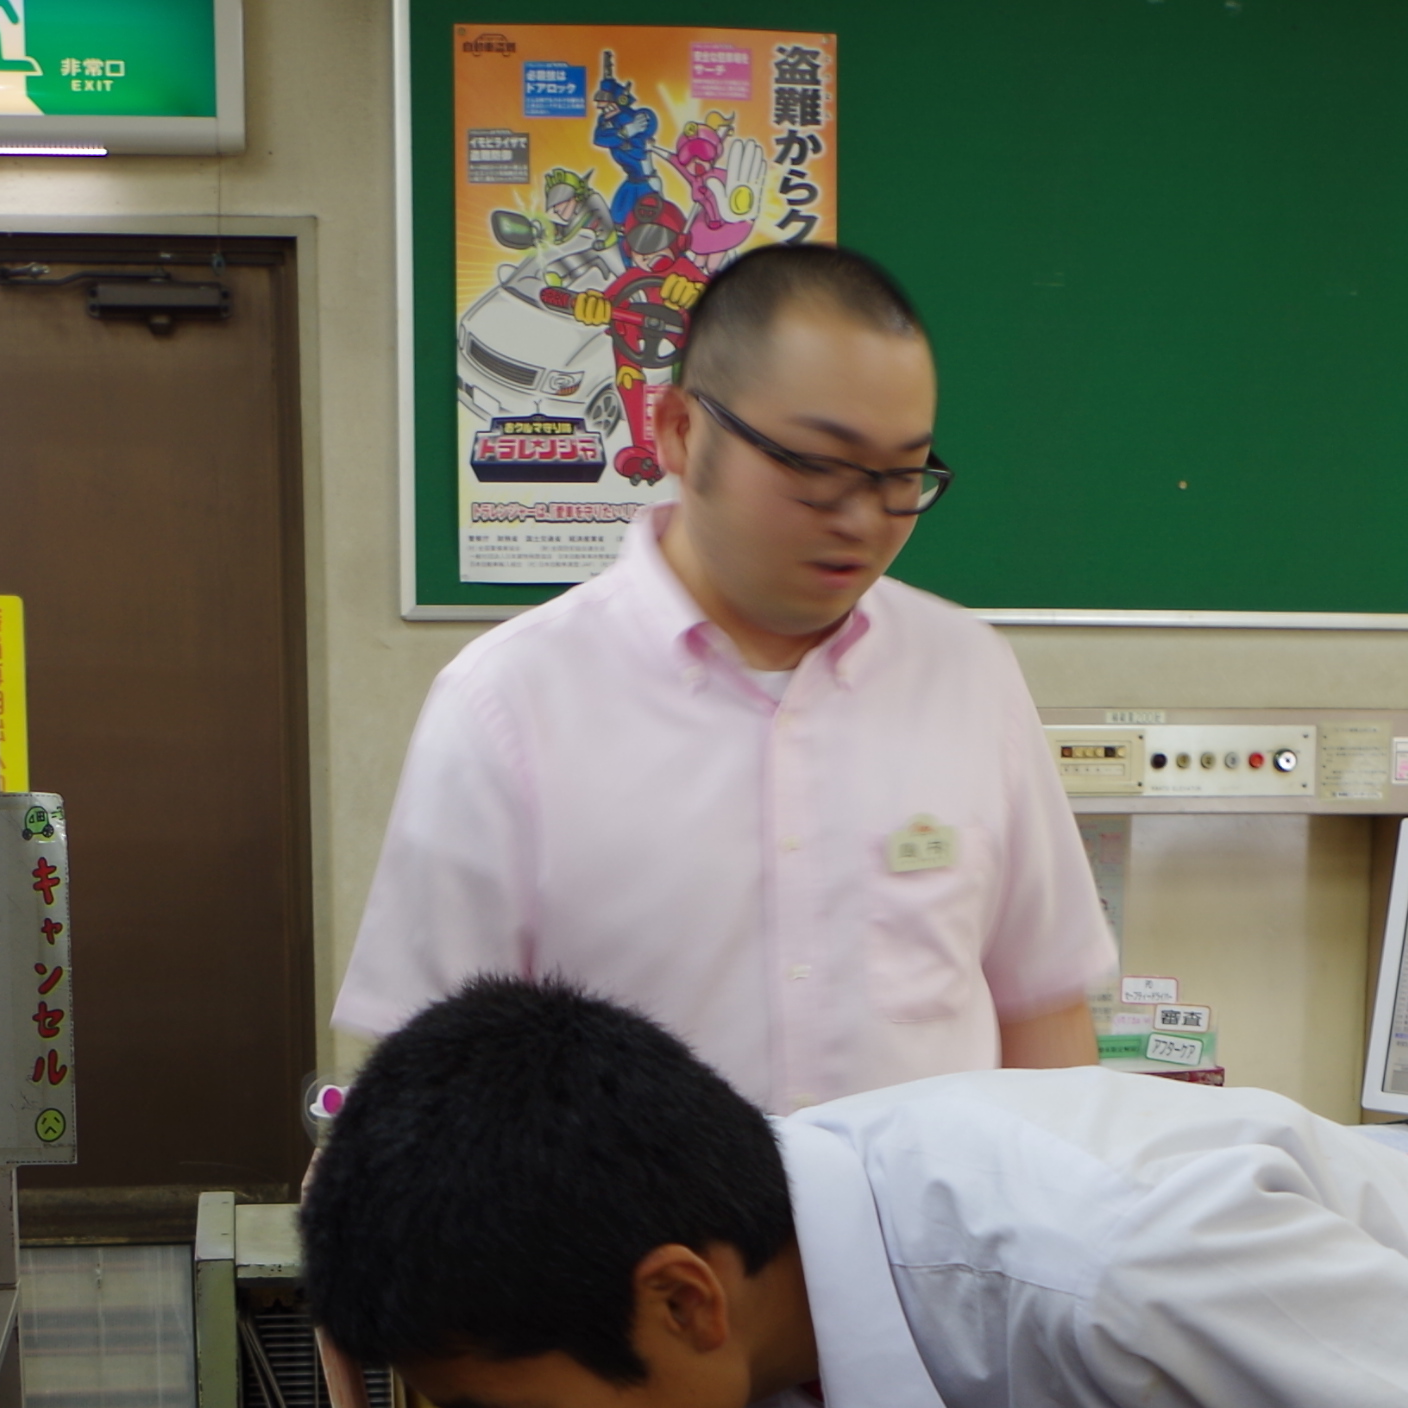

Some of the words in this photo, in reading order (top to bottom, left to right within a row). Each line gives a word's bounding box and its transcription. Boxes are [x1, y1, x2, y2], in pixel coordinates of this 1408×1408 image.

[60, 57, 125, 78] 非常口
[694, 66, 727, 75] サーチ
[71, 80, 114, 92] EXIT
[526, 83, 577, 95] ドアロック
[33, 857, 67, 1086] キャンセル
[1161, 1010, 1203, 1027] 審査
[1152, 1039, 1196, 1060] アフターケア
